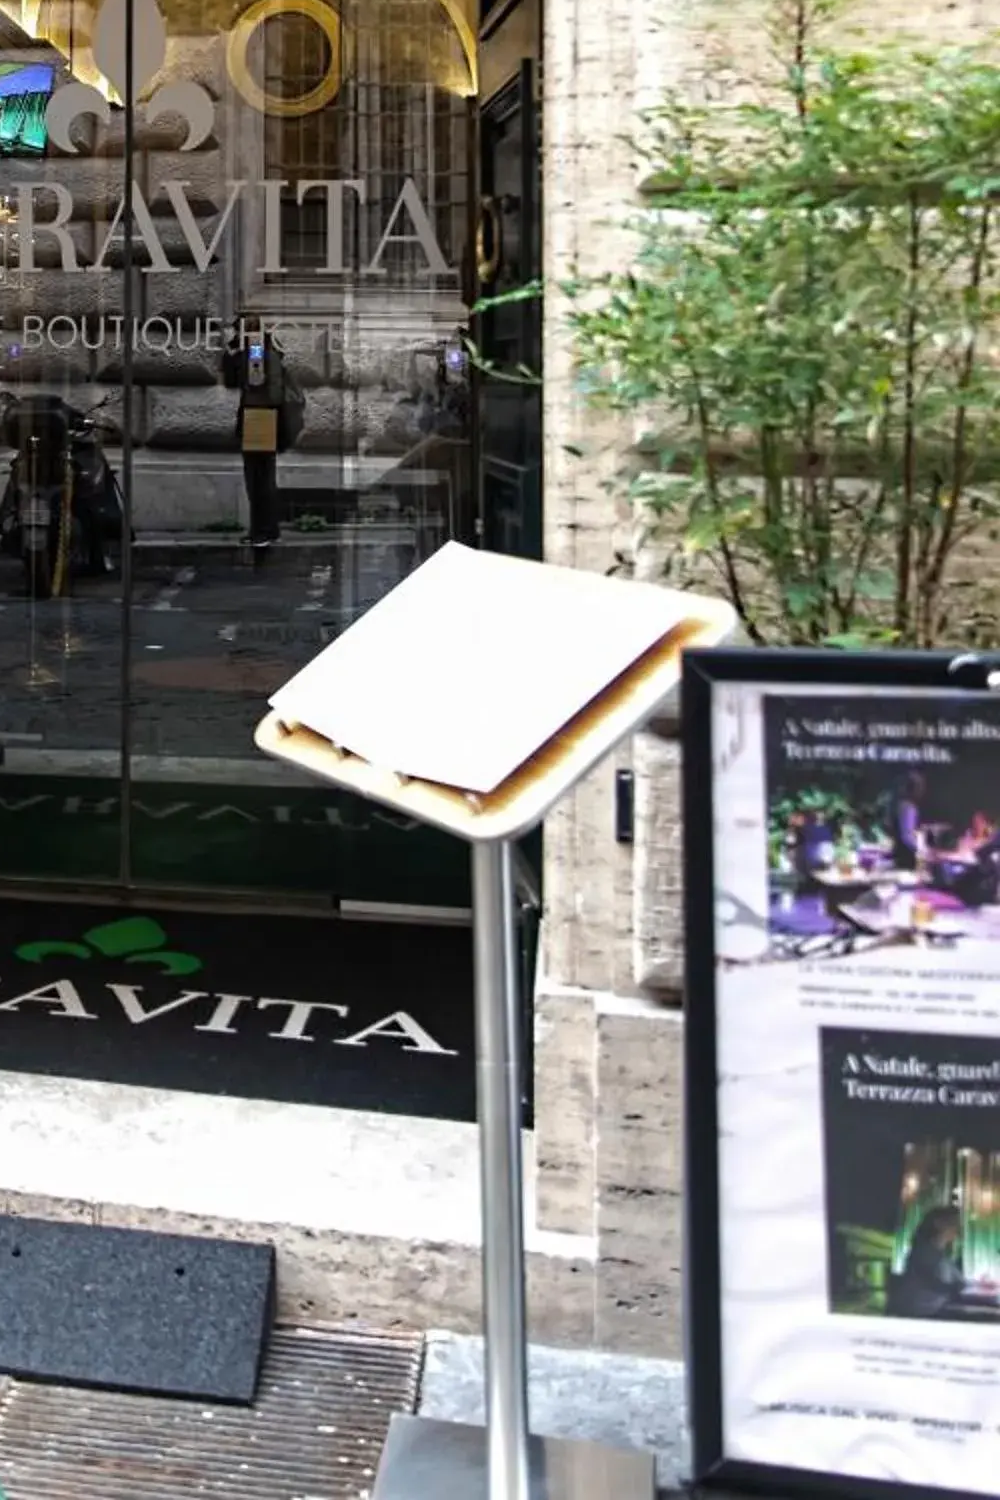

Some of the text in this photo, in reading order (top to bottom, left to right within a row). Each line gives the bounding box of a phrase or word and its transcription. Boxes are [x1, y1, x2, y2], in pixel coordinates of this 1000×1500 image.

[22, 315, 224, 357] BOUTIQUE
[842, 1052, 861, 1074] A
[841, 1078, 934, 1102] Terrazza
